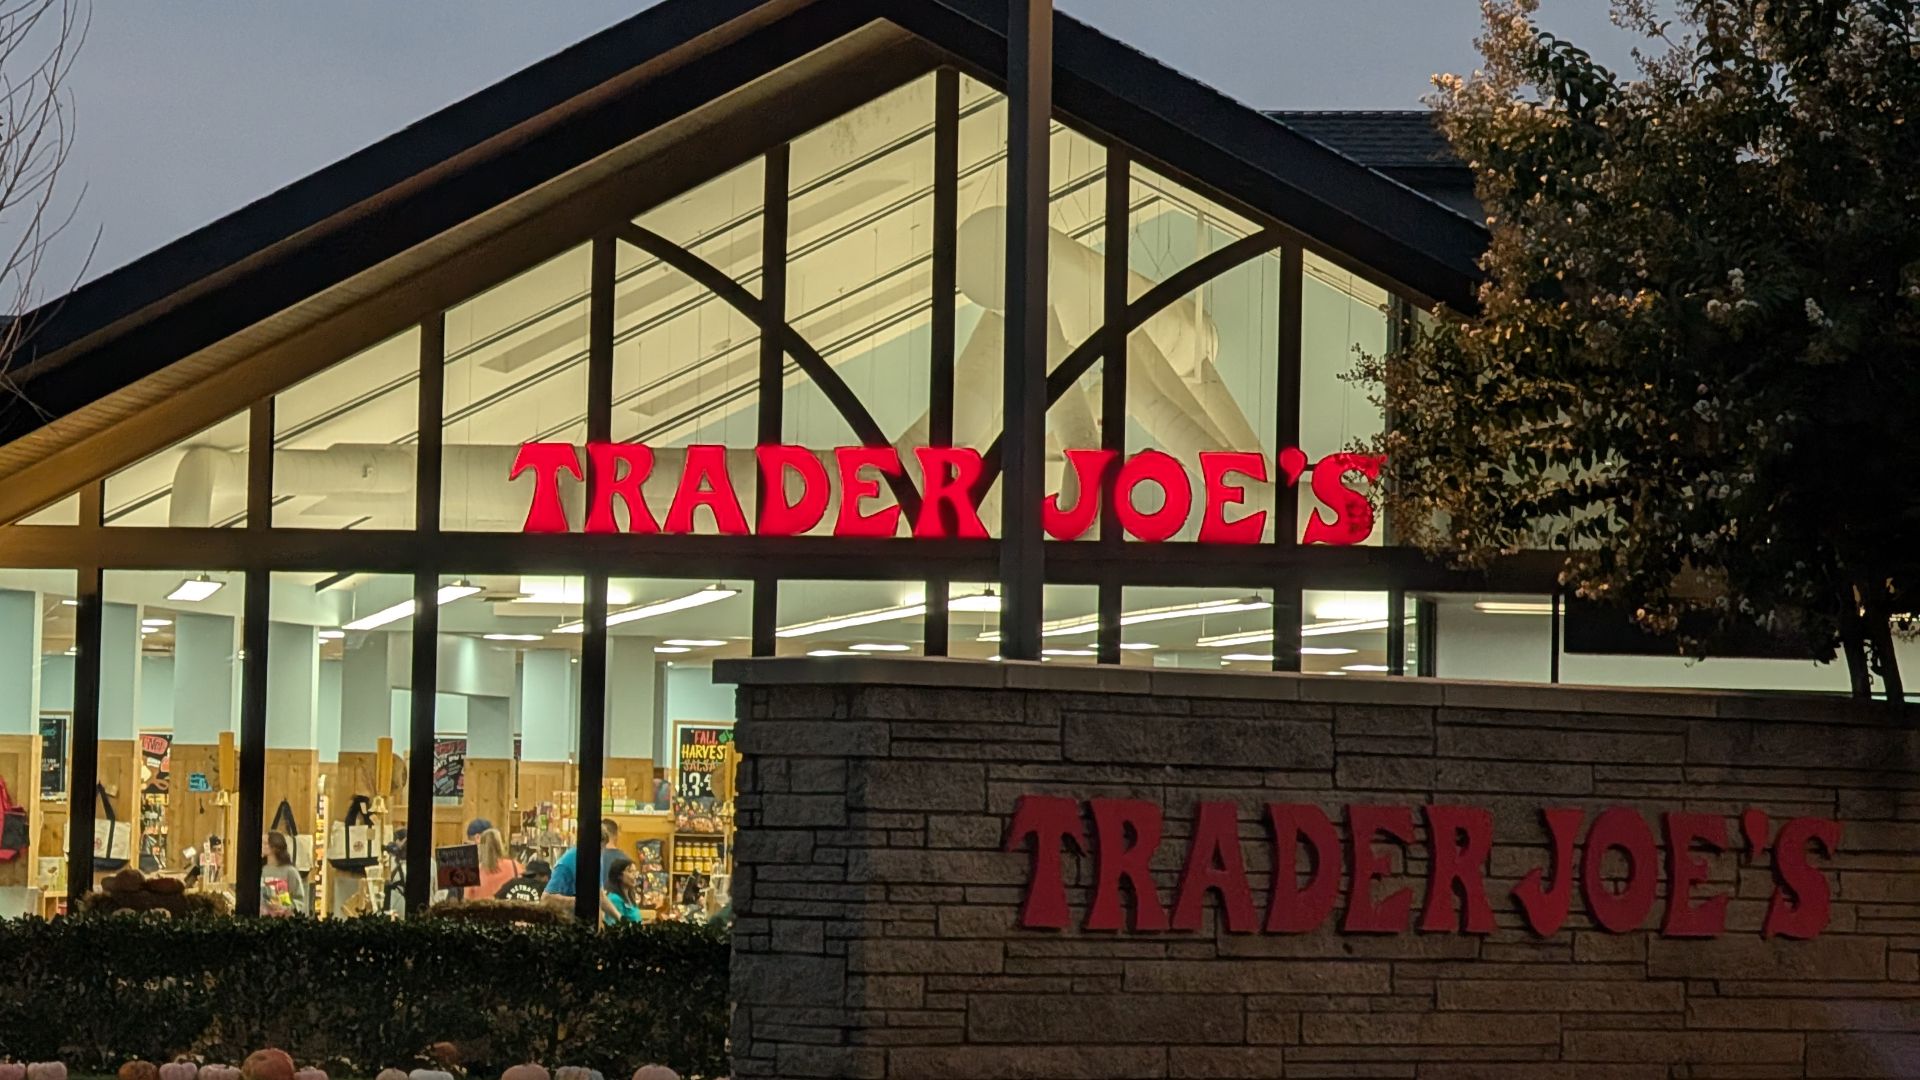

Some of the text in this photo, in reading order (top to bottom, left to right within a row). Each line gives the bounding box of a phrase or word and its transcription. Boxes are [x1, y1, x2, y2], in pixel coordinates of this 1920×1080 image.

[510, 442, 1388, 545] TRADER JOE'S
[683, 759, 717, 772] SALSA
[694, 730, 718, 744] FALL
[1007, 795, 1842, 939] TRADER JOE'S
